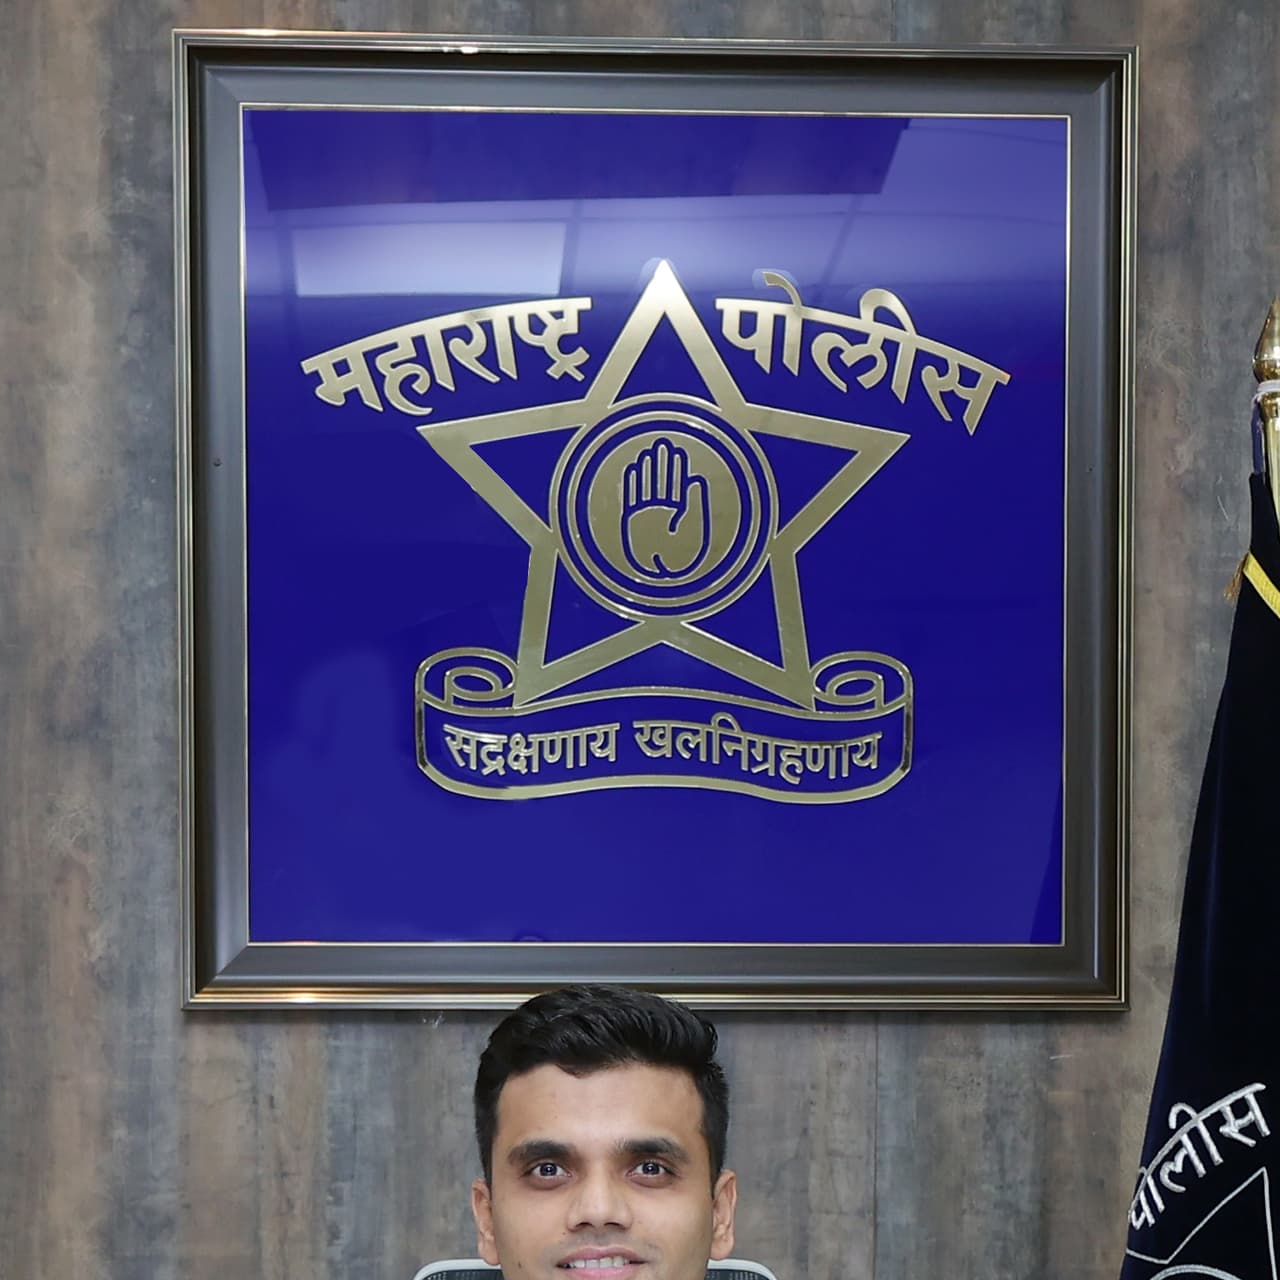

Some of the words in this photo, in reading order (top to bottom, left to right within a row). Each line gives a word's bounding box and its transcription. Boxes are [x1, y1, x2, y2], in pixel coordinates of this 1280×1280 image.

[300, 296, 592, 416] महाराष्ट्र
[715, 271, 1011, 436] पोलीस
[442, 721, 621, 776] सद्रक्षणाय
[632, 711, 883, 785] खलनिग्रहणाय
